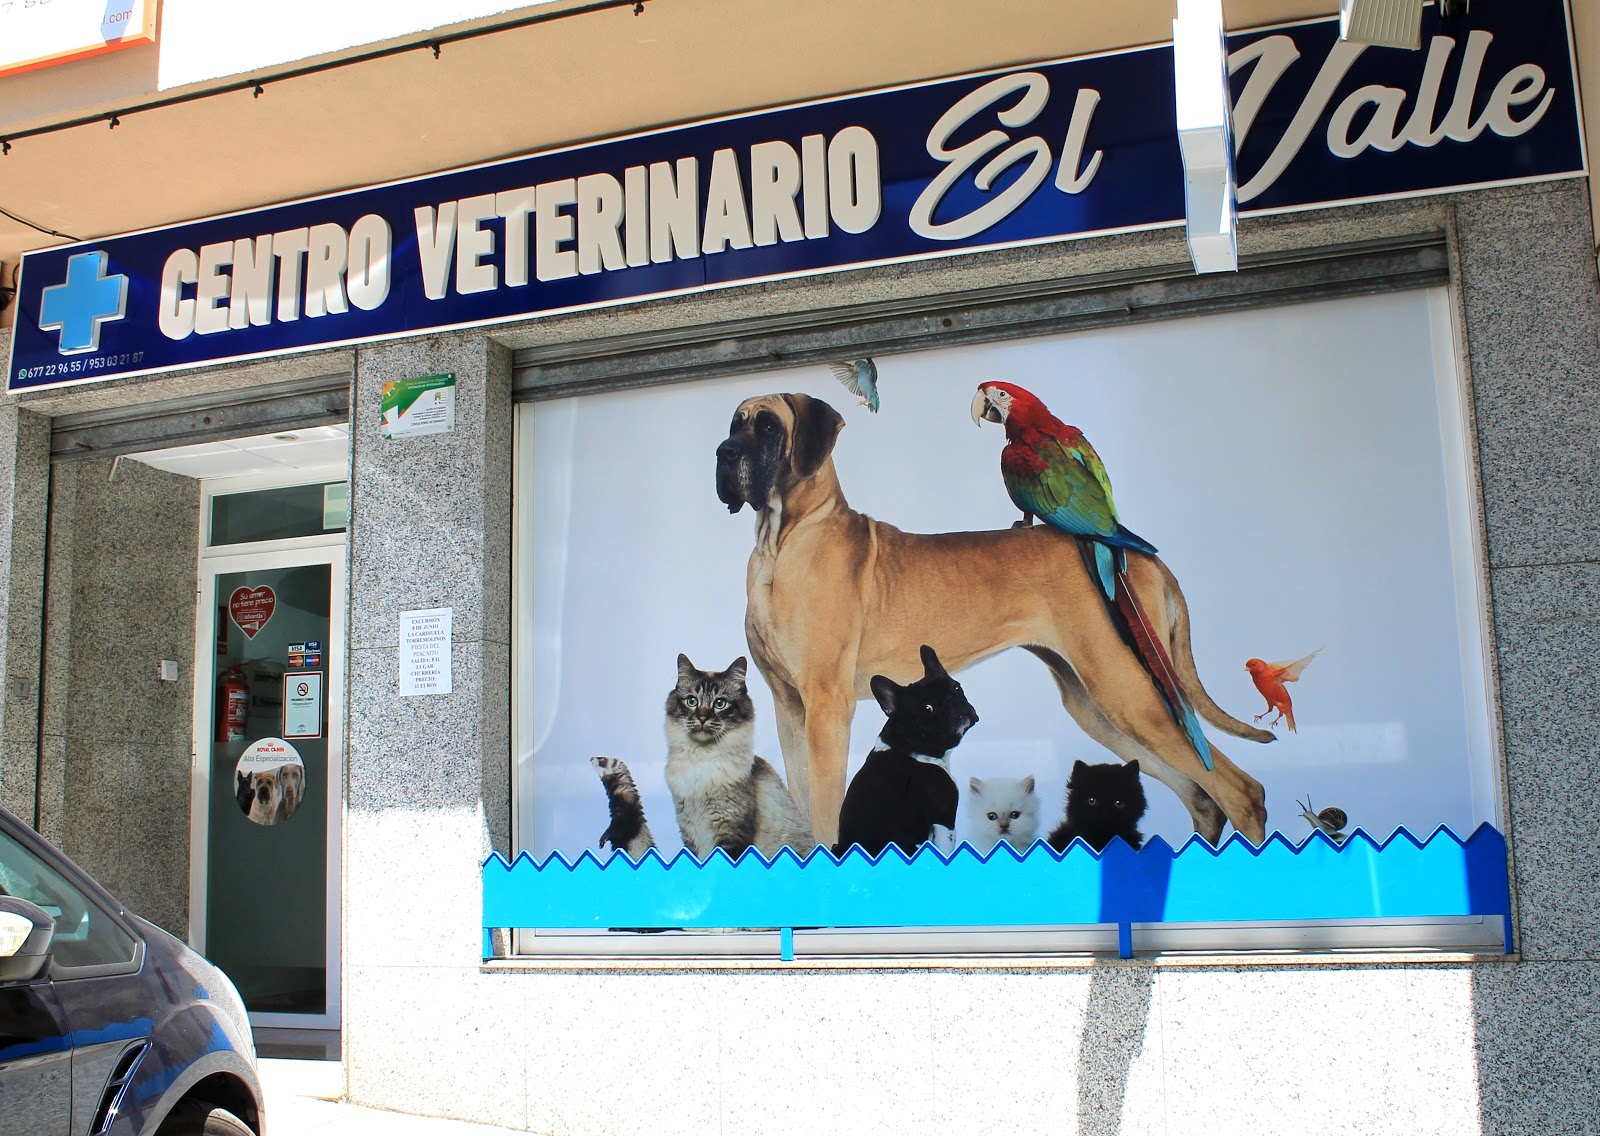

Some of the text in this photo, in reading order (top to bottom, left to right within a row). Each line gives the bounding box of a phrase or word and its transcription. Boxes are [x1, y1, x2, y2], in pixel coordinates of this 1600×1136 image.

[157, 213, 393, 342] CENTRO
[414, 125, 882, 301] VETERINARIO
[907, 71, 1104, 242] El
[28, 366, 44, 379] 677
[45, 364, 56, 376] 22
[58, 362, 69, 374] 96
[70, 360, 81, 372] 55
[89, 357, 105, 369] 953
[107, 355, 118, 367] 03
[119, 353, 130, 365] 21
[132, 351, 144, 363] 87
